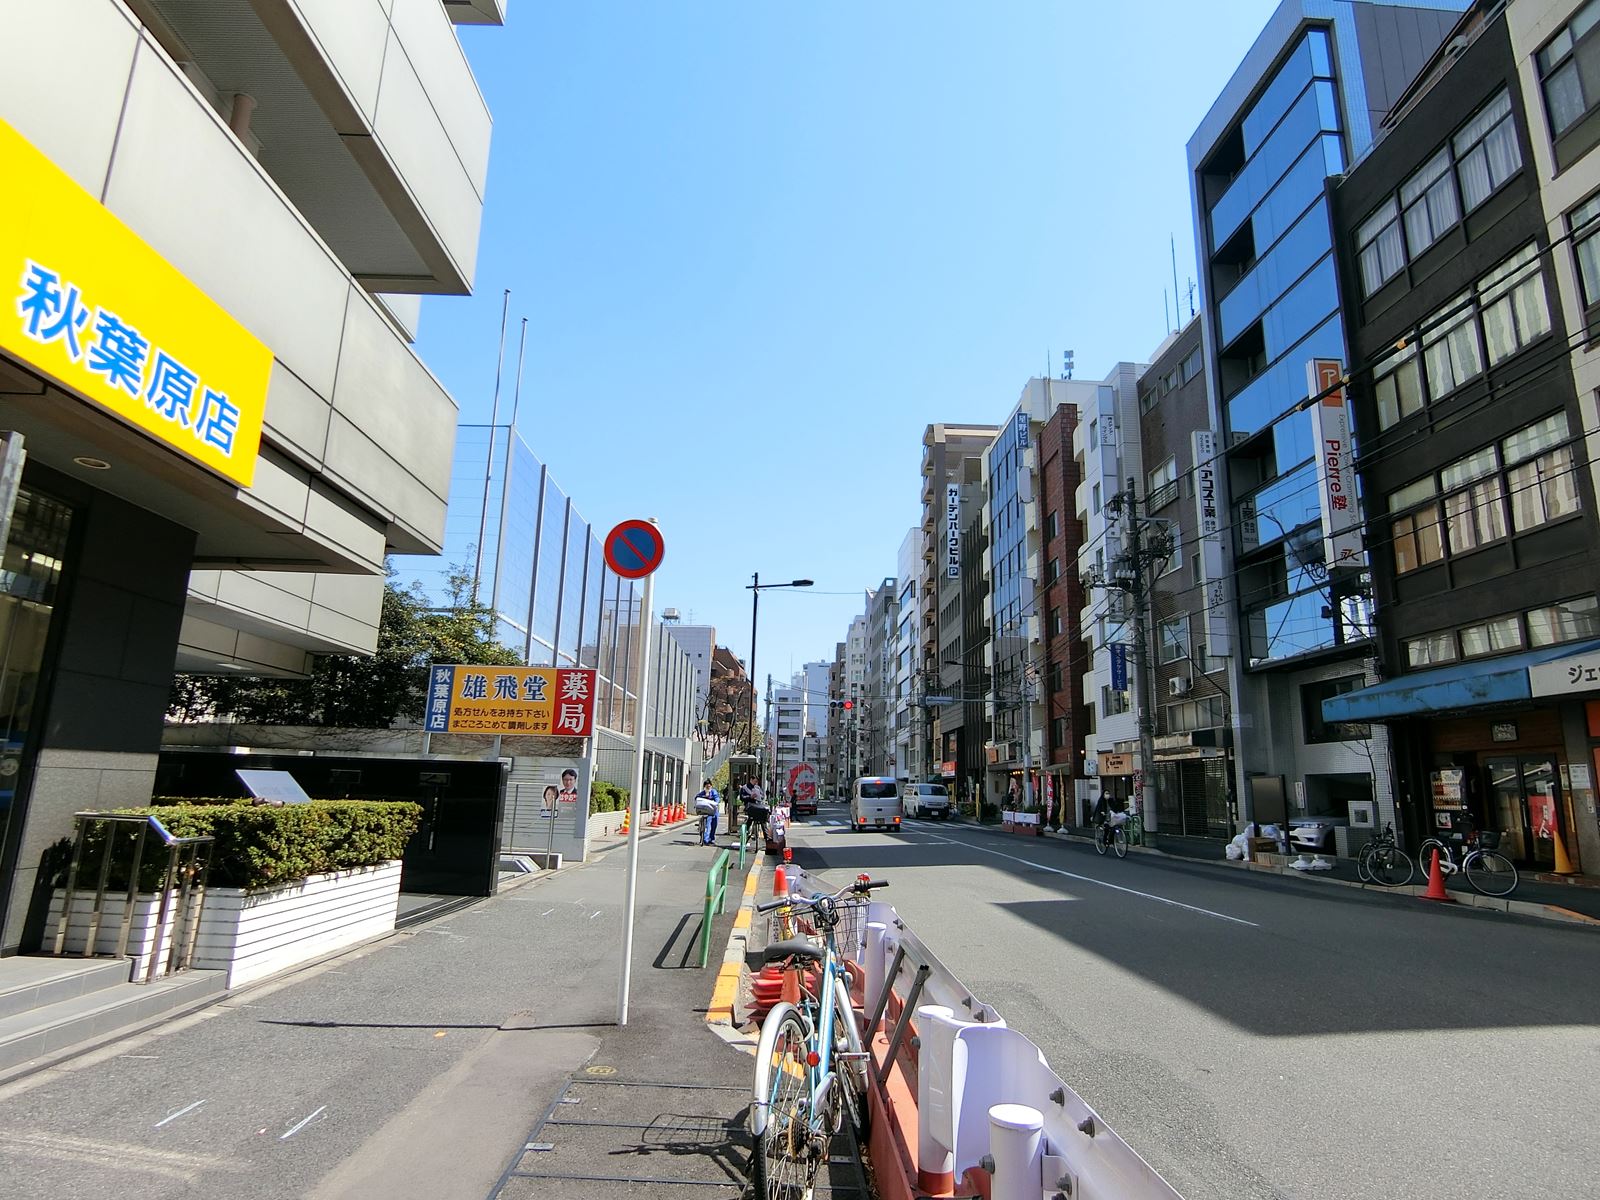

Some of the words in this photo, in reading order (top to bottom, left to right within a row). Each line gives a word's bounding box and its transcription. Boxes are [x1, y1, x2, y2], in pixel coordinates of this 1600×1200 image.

[18, 260, 241, 457] 秋葉原店
[1325, 440, 1342, 493] Pierre
[949, 488, 959, 565] ガーデンパークビル
[430, 668, 450, 729] 秋葉原店
[461, 674, 548, 701] 雄飛堂
[1567, 665, 1600, 684] ジェ
[452, 720, 549, 731] まごころこめて調剤します
[453, 707, 550, 719] 処方せんをお持ち下さい
[557, 672, 589, 733] 薬局
